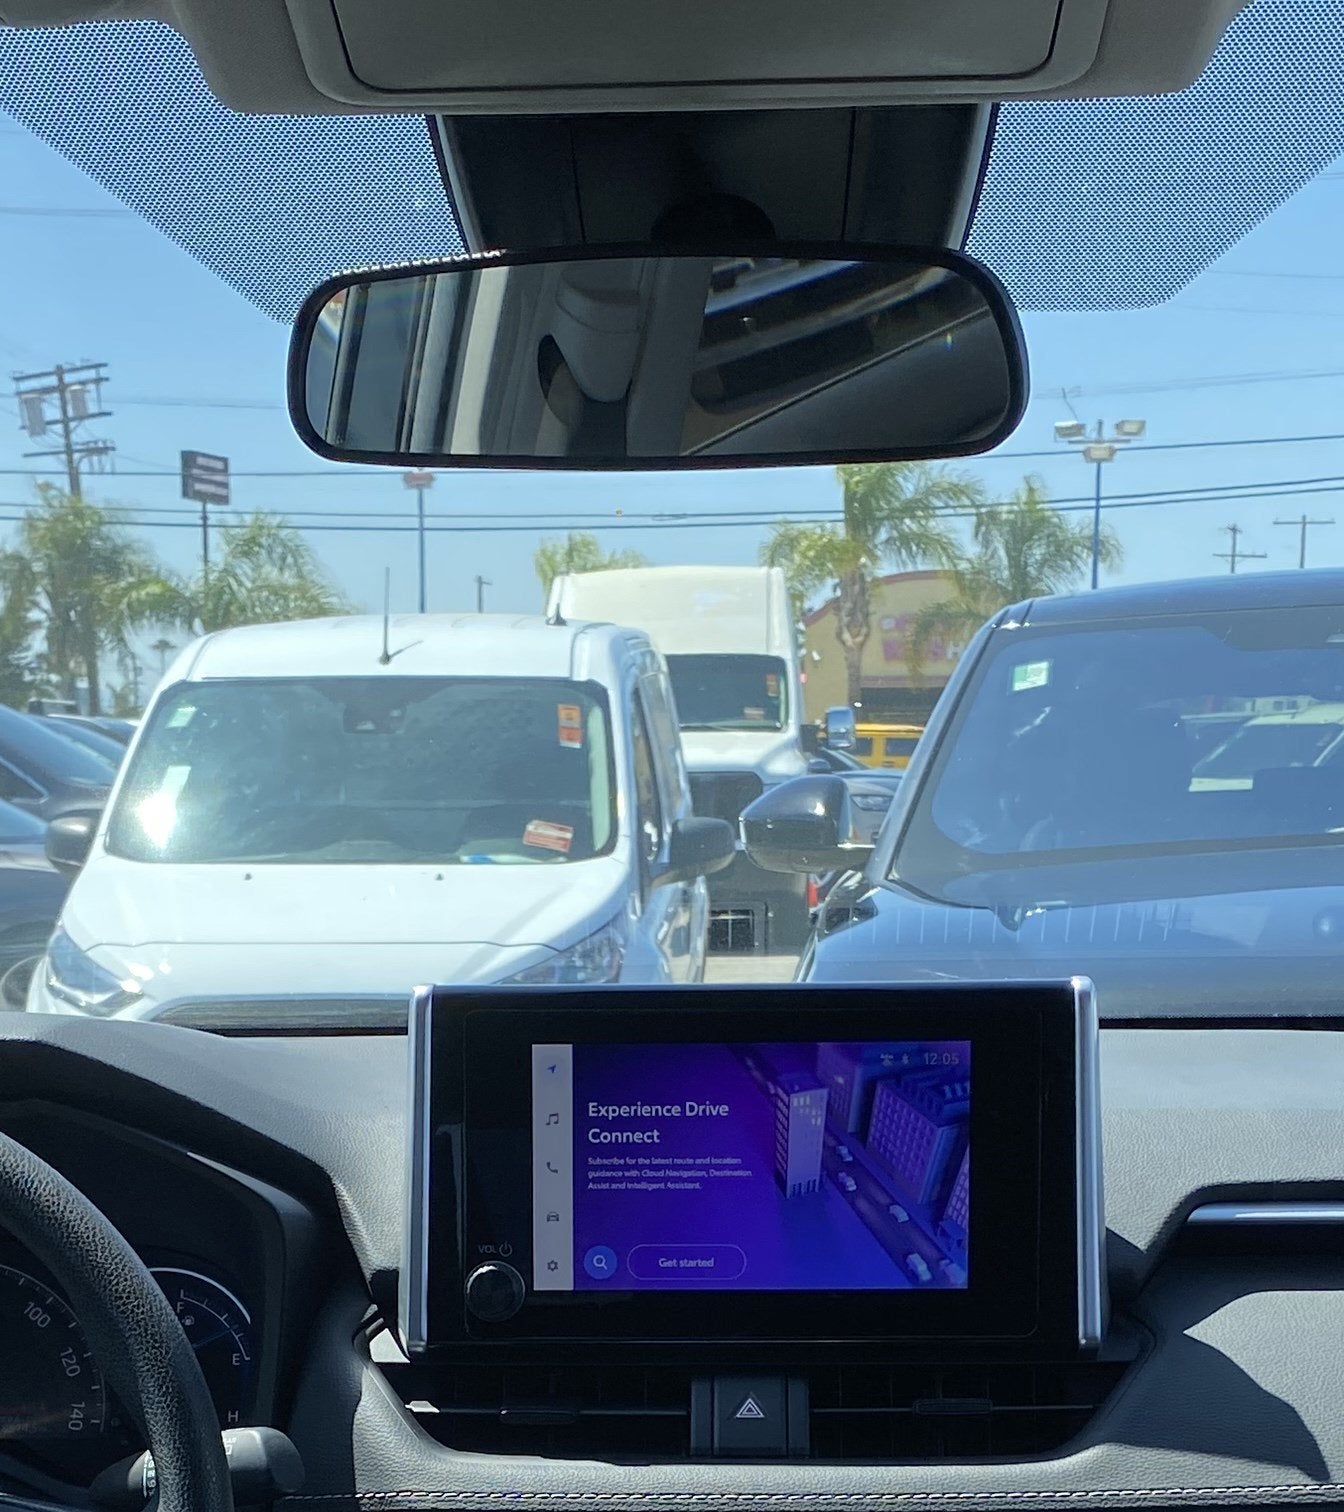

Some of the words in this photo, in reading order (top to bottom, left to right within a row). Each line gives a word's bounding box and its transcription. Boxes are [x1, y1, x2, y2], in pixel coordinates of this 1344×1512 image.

[588, 1101, 681, 1120] Experience
[685, 1101, 730, 1117] Drive
[588, 1128, 661, 1143] Connect
[588, 1157, 625, 1165] Subscribe
[626, 1157, 637, 1165] for
[638, 1157, 650, 1165] the
[651, 1157, 673, 1165] latest
[696, 1157, 710, 1165] and
[711, 1157, 742, 1165] location
[588, 1169, 622, 1178] guidance
[624, 1169, 640, 1177] with
[641, 1169, 664, 1177] Cloud
[709, 1169, 752, 1177] Destination
[588, 1181, 610, 1189] Assist
[627, 1181, 665, 1191] Intelligent
[659, 1258, 677, 1268] Get
[679, 1258, 715, 1268] started
[23, 1302, 52, 1328] 100
[59, 1346, 81, 1377] 120
[232, 1353, 241, 1366] E
[67, 1401, 86, 1432] 140
[228, 1410, 239, 1422] H
